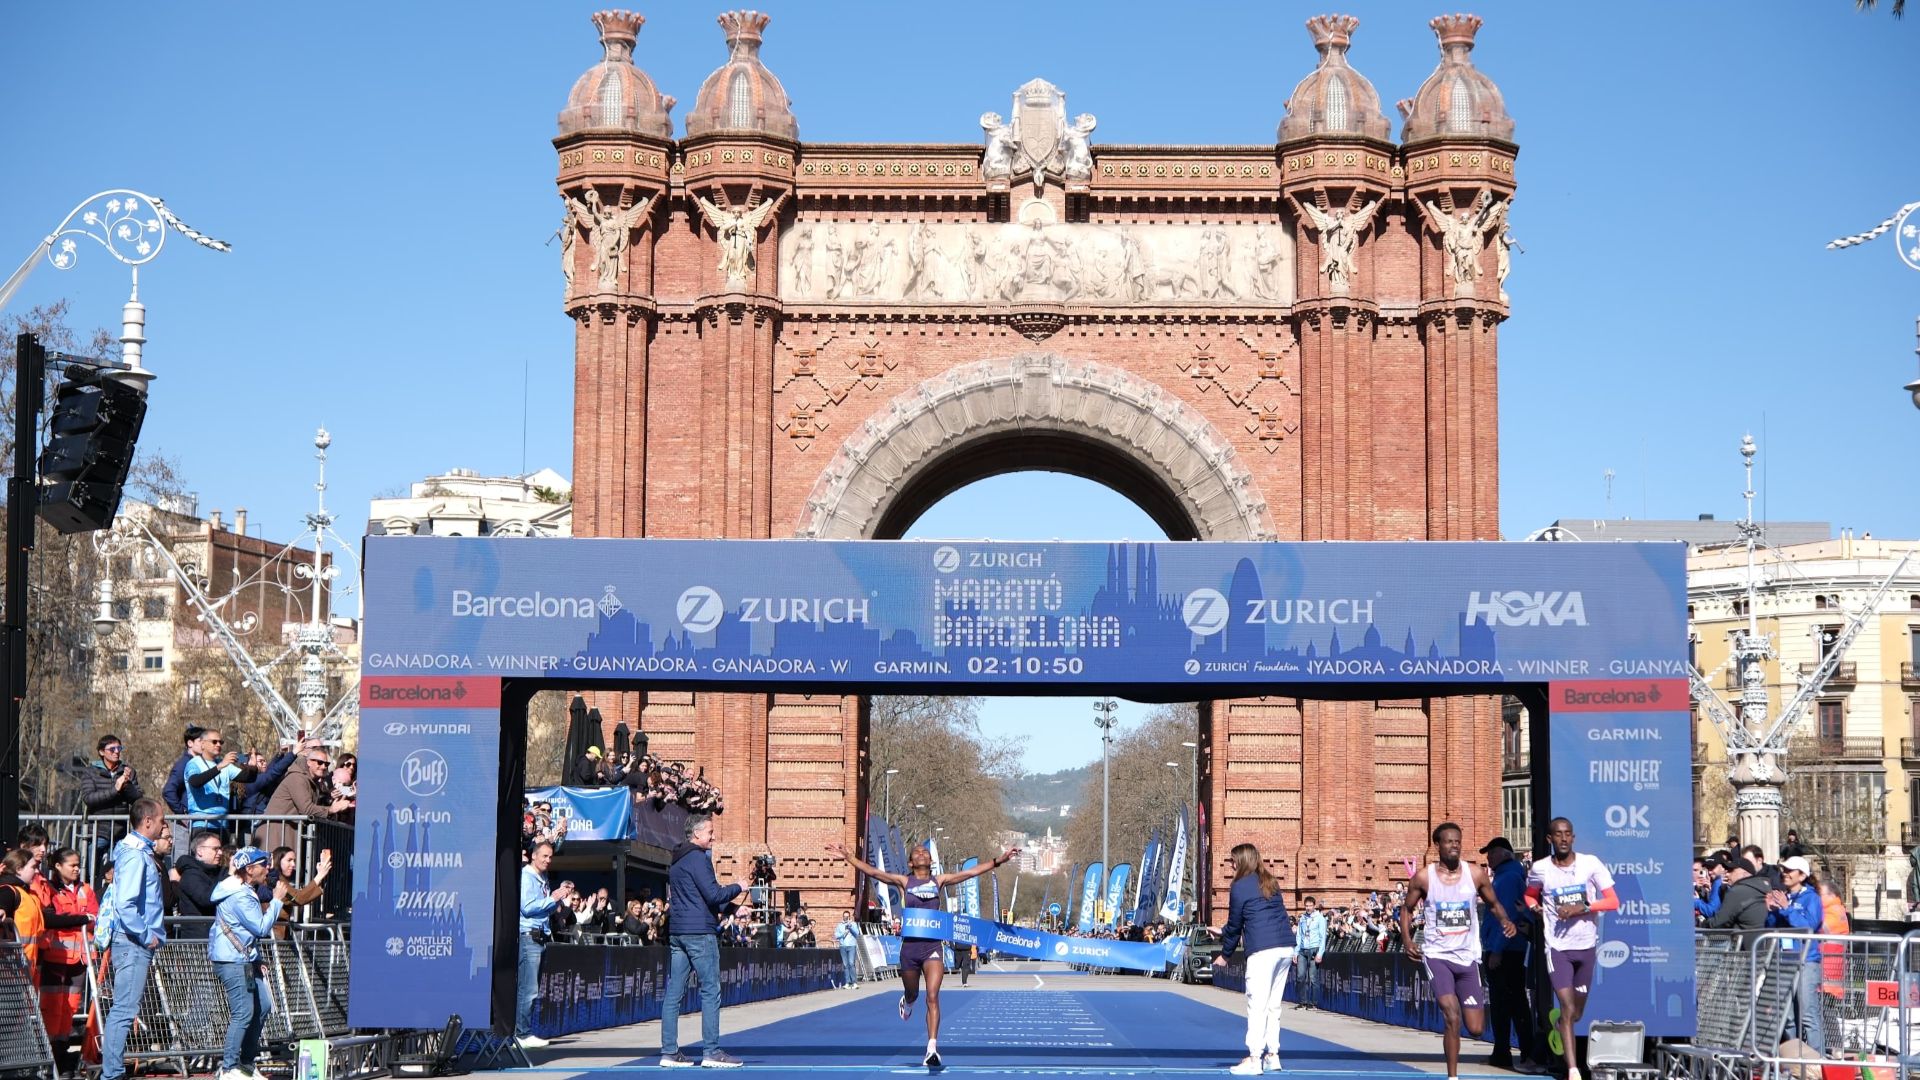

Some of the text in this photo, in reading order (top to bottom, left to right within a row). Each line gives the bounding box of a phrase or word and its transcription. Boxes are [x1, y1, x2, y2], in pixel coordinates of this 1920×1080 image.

[969, 553, 1042, 567] ZURICH
[934, 572, 1062, 611] MARATÓ
[452, 590, 595, 618] Barcelona
[739, 598, 869, 623] ZURICH
[1245, 599, 1374, 624] ZURICH
[1465, 591, 1587, 626] HOKA
[934, 615, 1120, 647] BARCELONA
[368, 653, 473, 669] GANADORA
[487, 655, 558, 670] WINNER
[573, 656, 697, 673] GUANYADORA
[712, 658, 816, 674] GANADORA
[967, 656, 1083, 674] 02:10:50
[1205, 662, 1247, 672] ZURICH
[1253, 661, 1300, 673] Foundation
[1400, 660, 1504, 675] GANADORA
[1517, 660, 1589, 675] WINNER
[370, 685, 451, 700] Barcelona
[1564, 689, 1646, 704] Barcelona
[411, 724, 470, 734] HYUNDAI
[1589, 760, 1659, 783] FINISHER
[416, 807, 451, 823] i-run
[1605, 805, 1650, 829] OK
[405, 853, 463, 868] YAMAHA
[396, 891, 456, 909] BIKKOA
[1080, 889, 1095, 923] HOKA
[1559, 893, 1582, 904] PACER
[1441, 910, 1465, 919] PACER
[1617, 900, 1671, 915] vithas
[906, 918, 941, 929] ZURICH
[407, 936, 453, 945] AMETLLER
[996, 931, 1033, 949] Barcelona
[406, 945, 452, 956] ORIGEN
[1072, 946, 1109, 957] ZURICH
[1603, 950, 1625, 958] TMB
